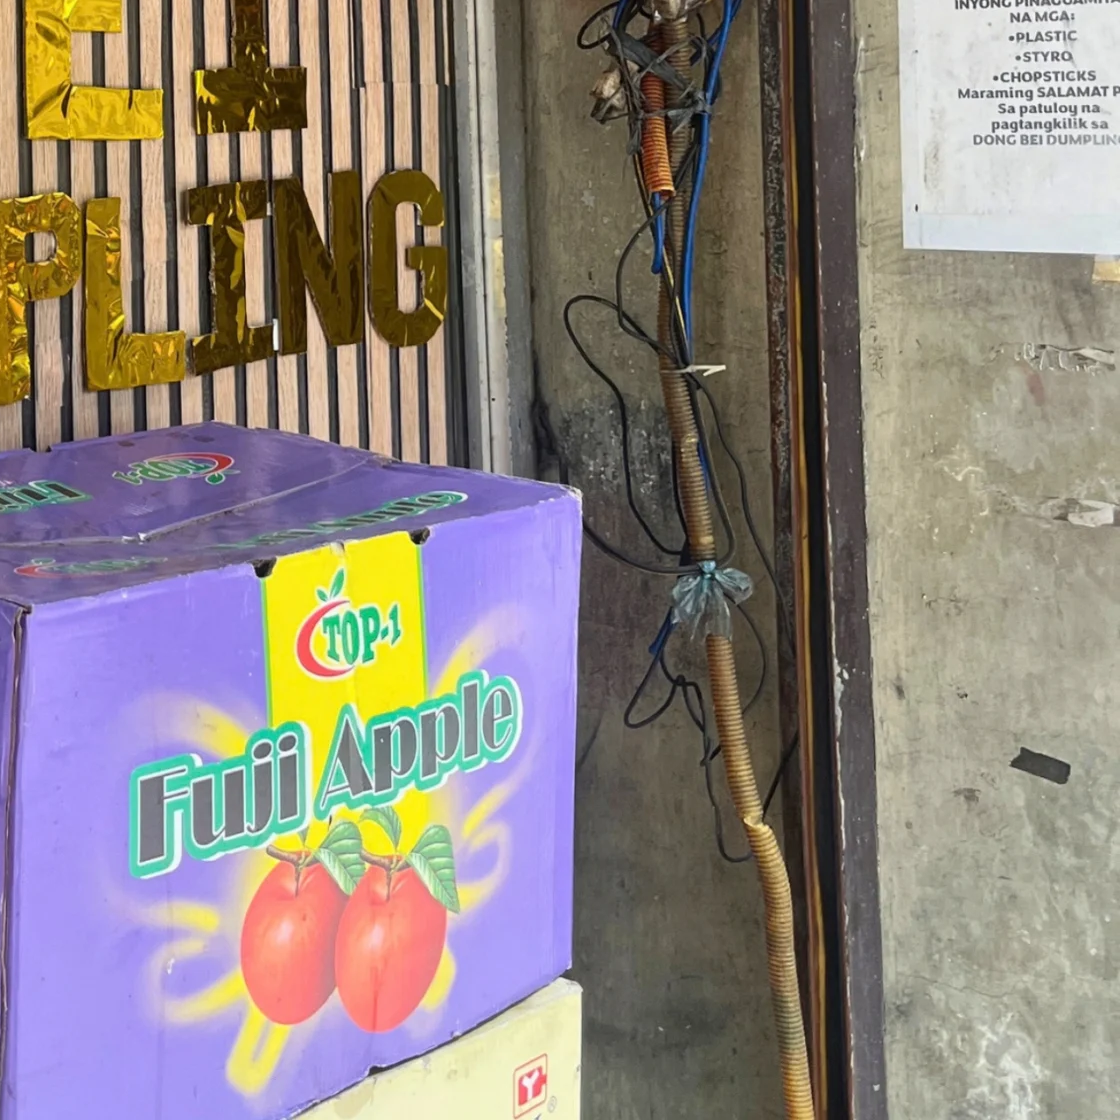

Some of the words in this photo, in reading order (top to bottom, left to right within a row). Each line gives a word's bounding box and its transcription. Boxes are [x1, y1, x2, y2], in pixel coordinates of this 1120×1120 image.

[1010, 12, 1032, 23] NA
[1035, 10, 1075, 22] MGA:
[958, 87, 1033, 101] Maraming
[1037, 85, 1109, 98] SALAMAT
[998, 103, 1016, 114] Sa
[1020, 102, 1078, 117] patuloy
[1081, 104, 1100, 113] na
[991, 118, 1088, 133] pagtangkilik
[1091, 120, 1109, 130] sa
[973, 134, 1017, 145] DONG
[1020, 134, 1043, 145] BEI
[320, 602, 402, 666] TOP-1
[134, 728, 305, 871] Fuji
[317, 675, 519, 815] Apple
